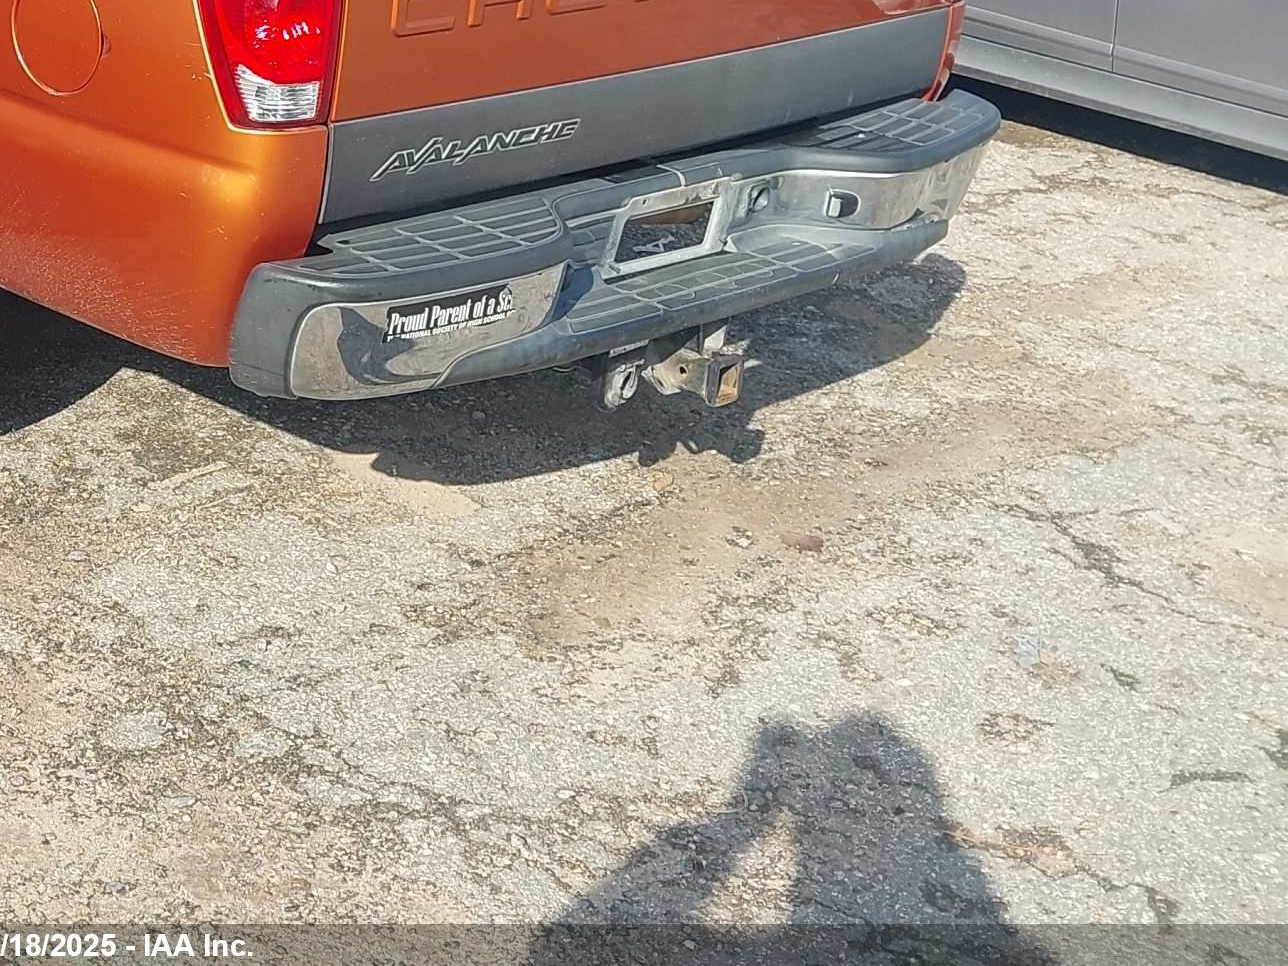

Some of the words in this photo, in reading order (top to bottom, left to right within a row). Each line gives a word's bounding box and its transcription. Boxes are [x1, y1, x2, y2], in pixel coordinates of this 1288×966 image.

[369, 118, 581, 182] AVALANCHE
[388, 307, 429, 335] Proud
[429, 298, 472, 327] Parent
[472, 295, 488, 318] of
[487, 298, 496, 315] a
